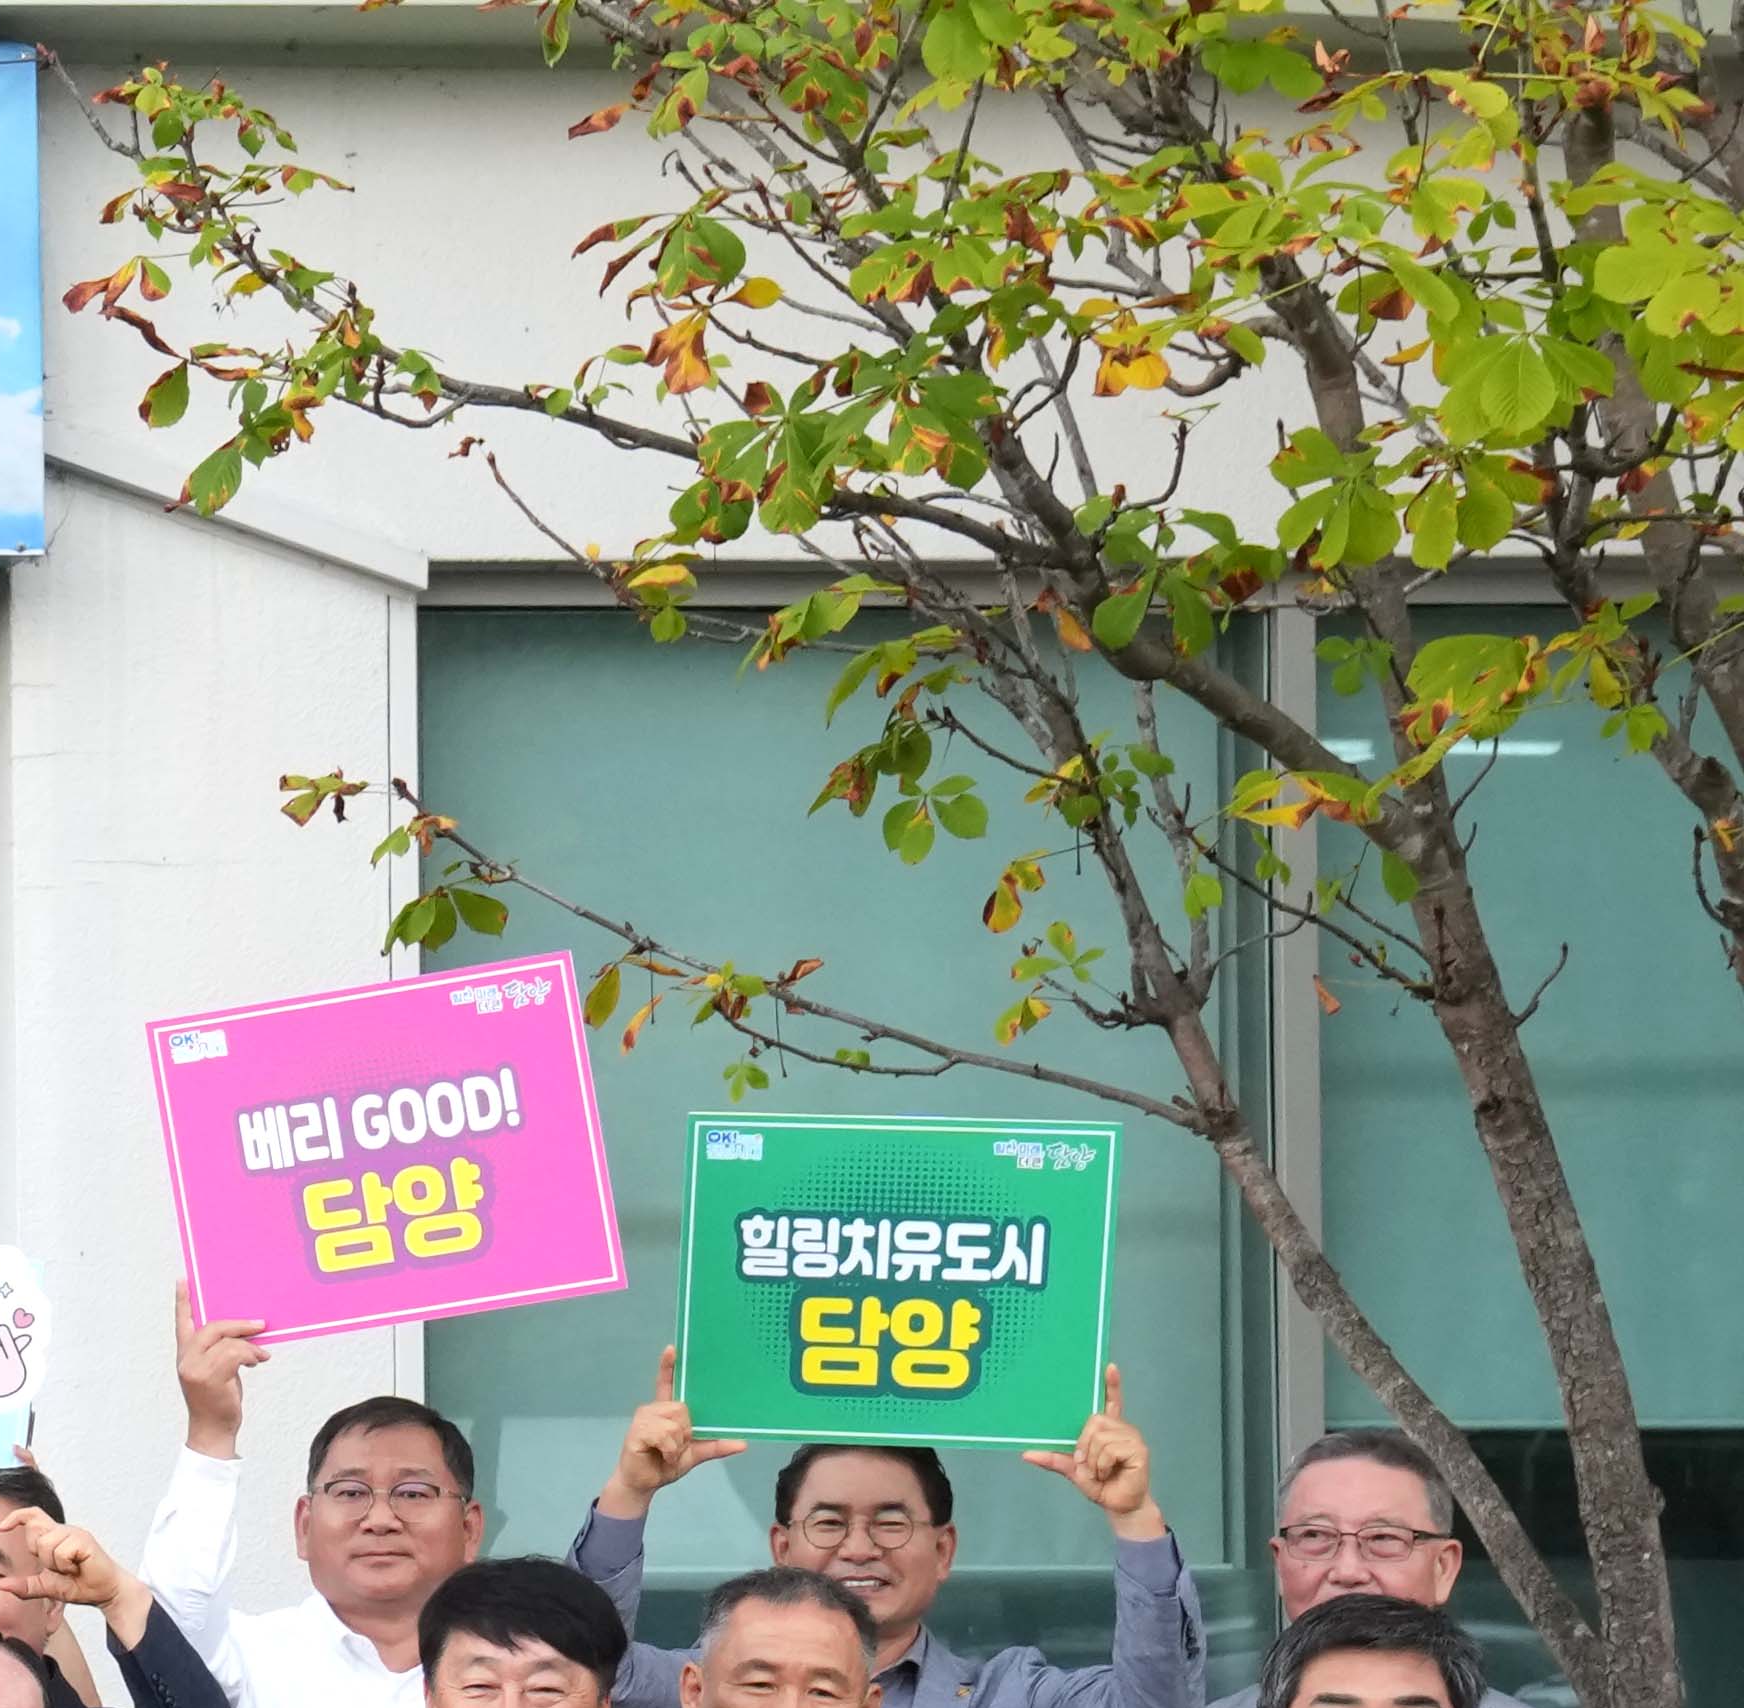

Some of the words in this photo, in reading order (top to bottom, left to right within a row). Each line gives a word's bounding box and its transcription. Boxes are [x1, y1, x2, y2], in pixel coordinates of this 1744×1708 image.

[238, 1096, 345, 1171] 베리
[351, 1067, 521, 1150] GOOD!
[303, 1156, 485, 1273] 담양
[739, 1214, 1046, 1285] 힐링치유도시
[800, 1295, 982, 1389] 담양
